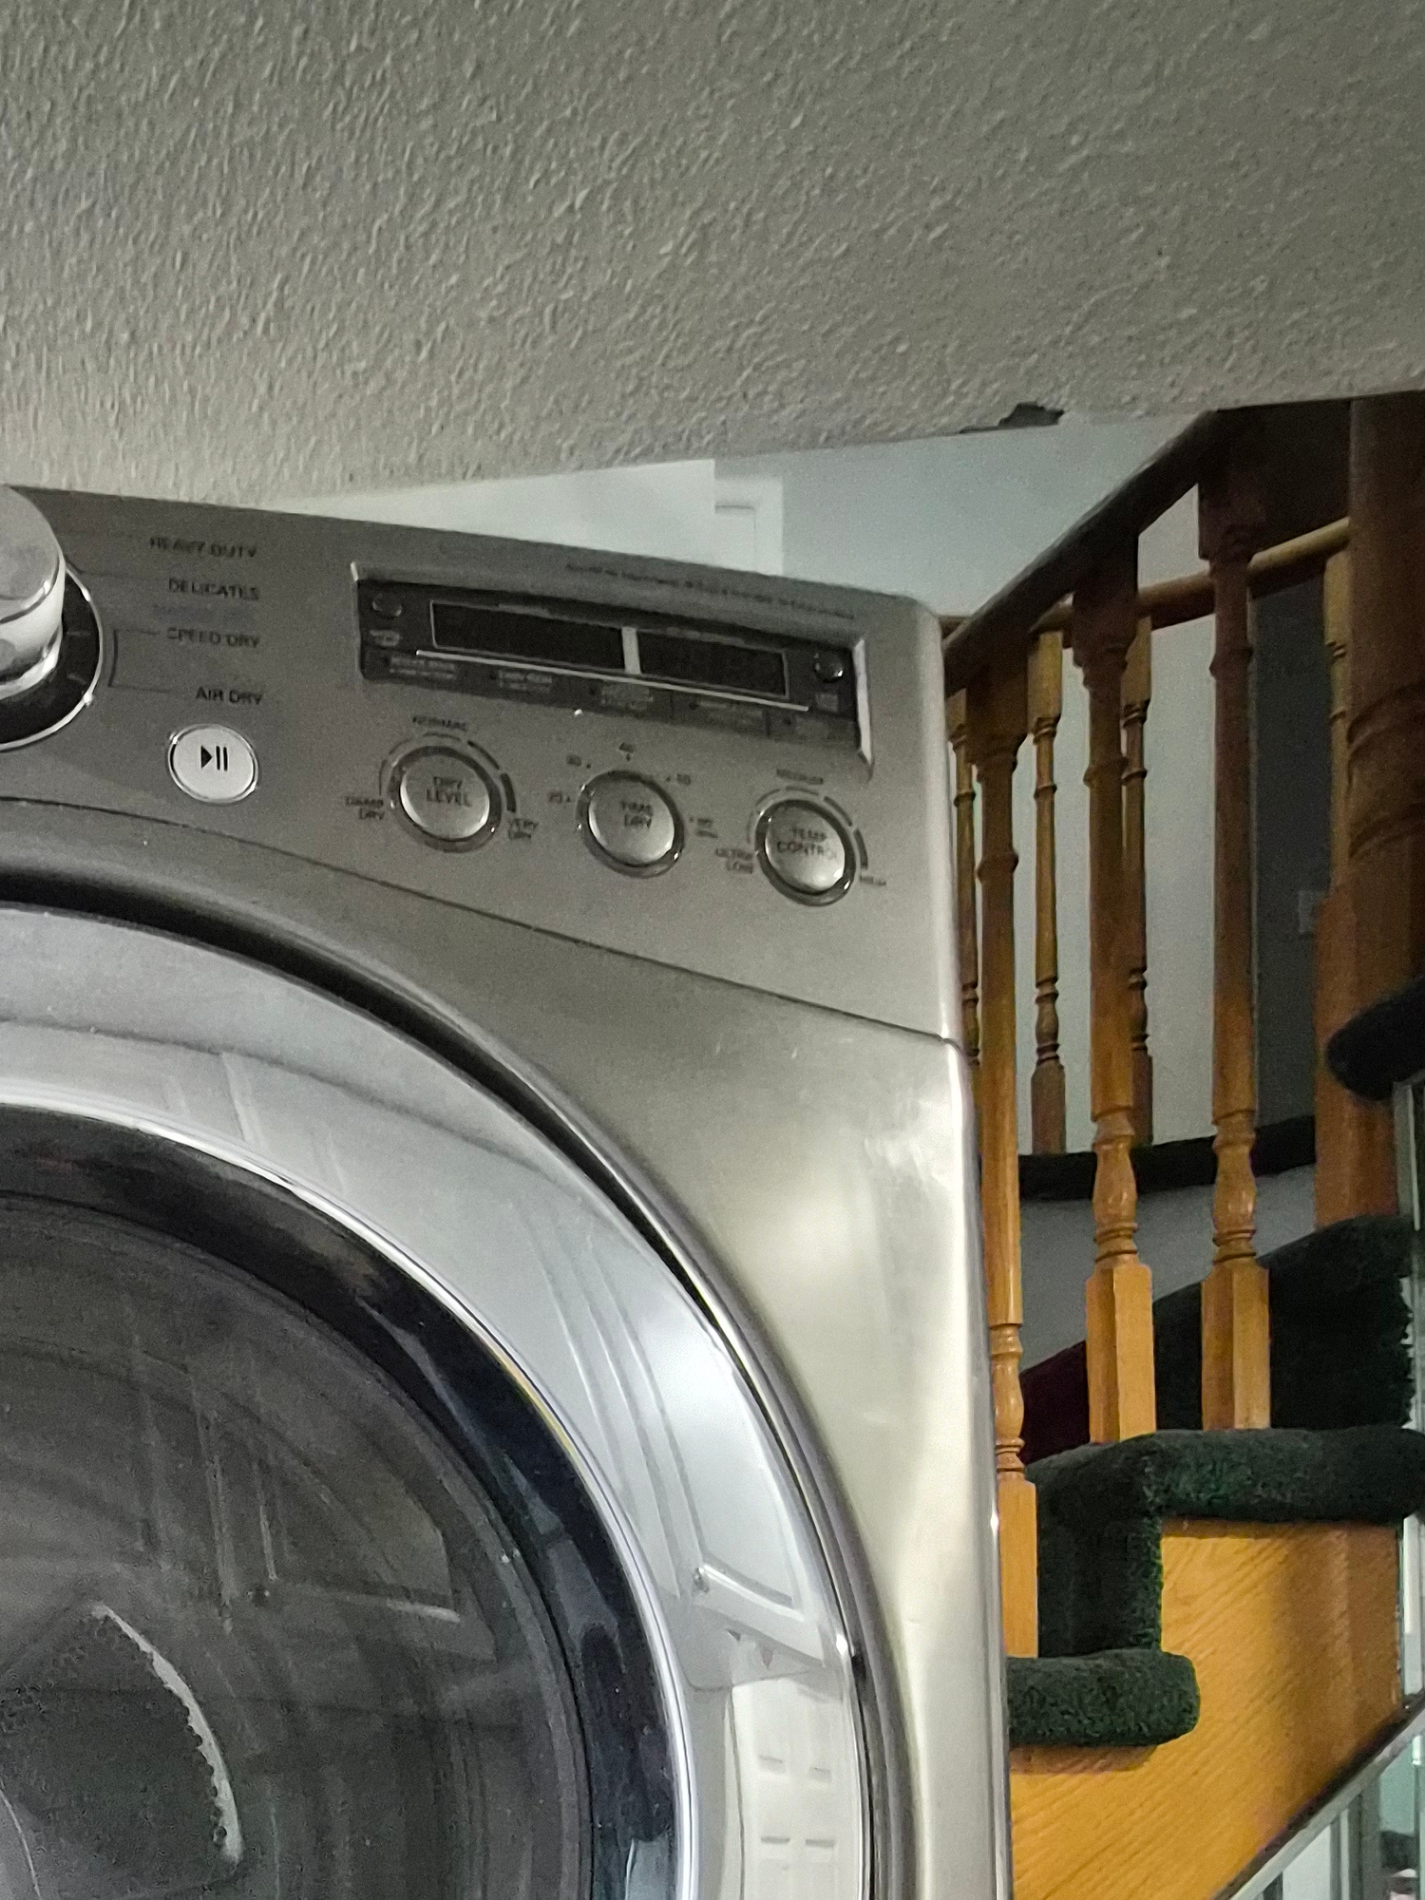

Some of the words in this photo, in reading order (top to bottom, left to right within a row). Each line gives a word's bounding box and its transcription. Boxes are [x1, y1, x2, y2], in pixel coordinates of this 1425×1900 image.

[168, 577, 260, 600] DELICATES
[195, 686, 224, 701] AIR
[228, 689, 264, 705] DRY
